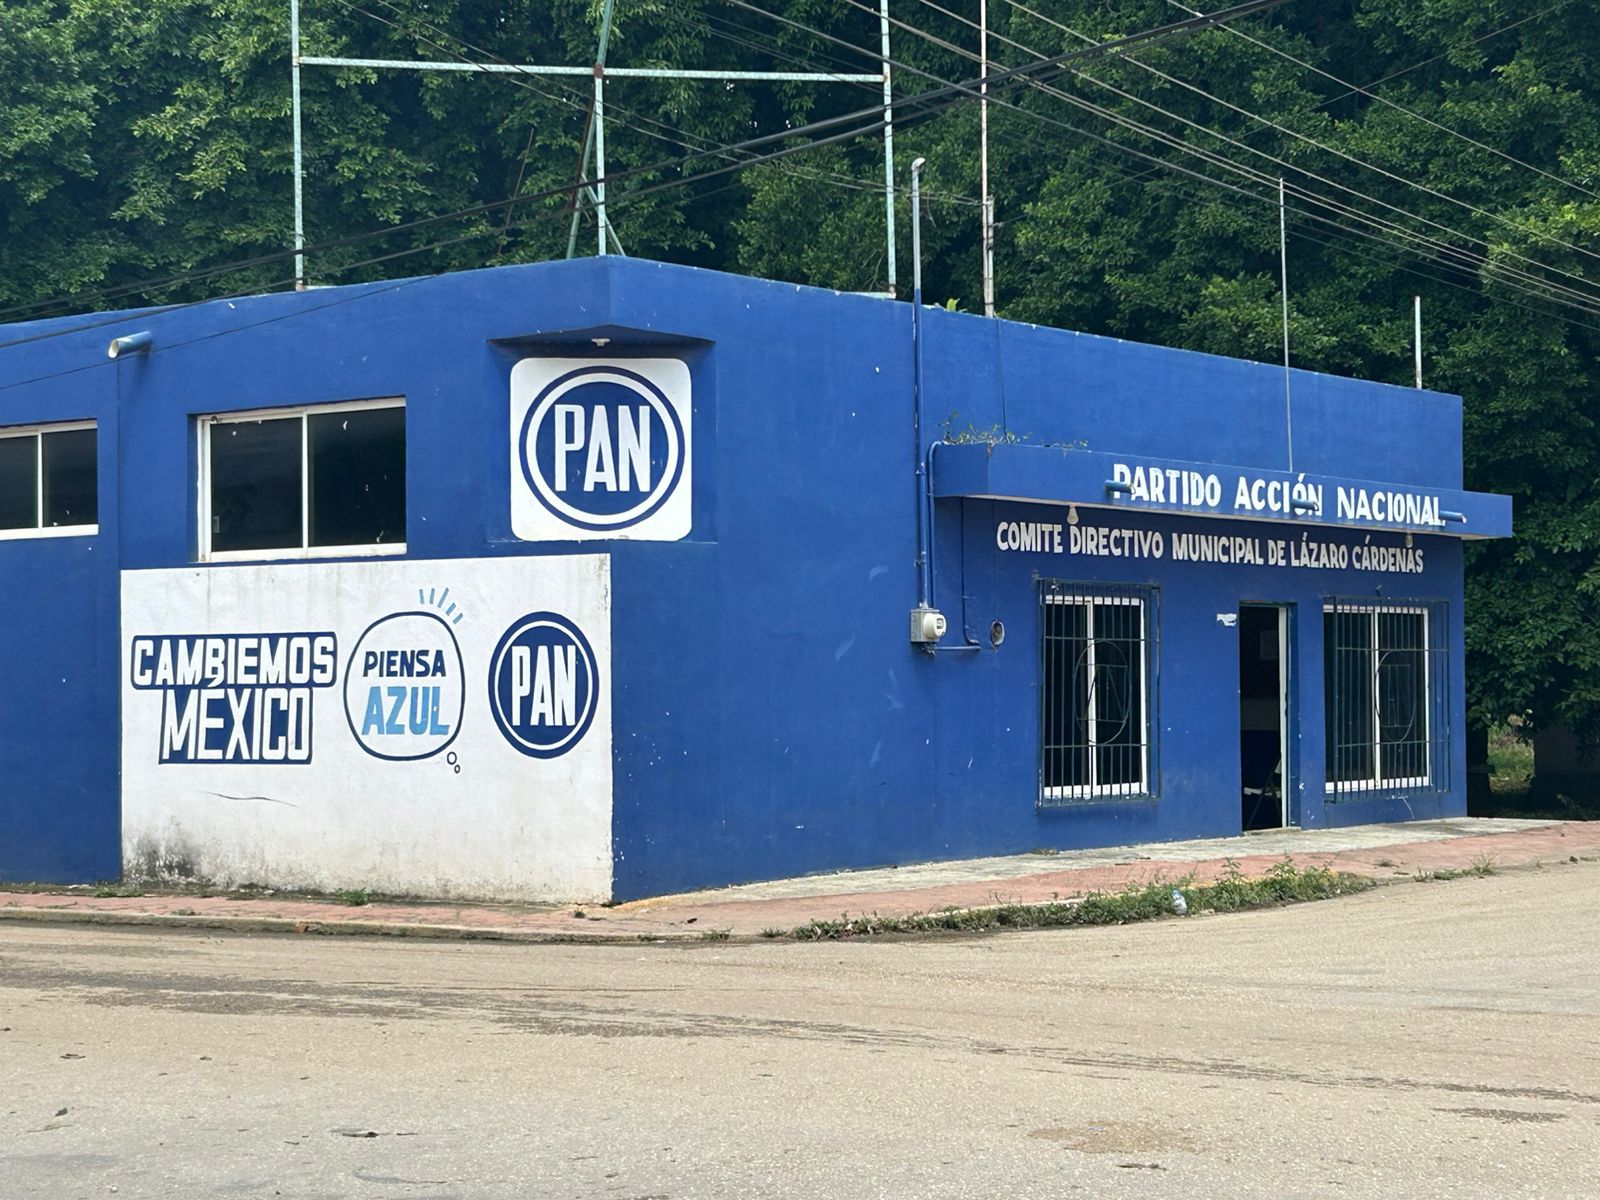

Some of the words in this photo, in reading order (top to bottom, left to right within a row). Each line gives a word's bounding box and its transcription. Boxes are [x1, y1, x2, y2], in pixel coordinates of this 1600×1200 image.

[554, 403, 651, 493] PAN
[1113, 463, 1222, 508] PARTIDO
[1233, 472, 1323, 517] ACCIÓN
[1337, 486, 1446, 527] NACIONAL
[996, 521, 1063, 554] COMITE
[1069, 525, 1164, 559] DIRECTIVO
[1171, 532, 1265, 565] MUNICIPAL
[1267, 539, 1286, 567] DE
[1290, 531, 1349, 570] LÁZARO
[1352, 534, 1424, 574] CÁRDENAS
[132, 635, 336, 686] CAMBIEMOS
[362, 649, 447, 679] PIENSA
[510, 644, 577, 728] PAN
[161, 677, 311, 762] MÉXICO
[361, 685, 451, 737] AZUL
